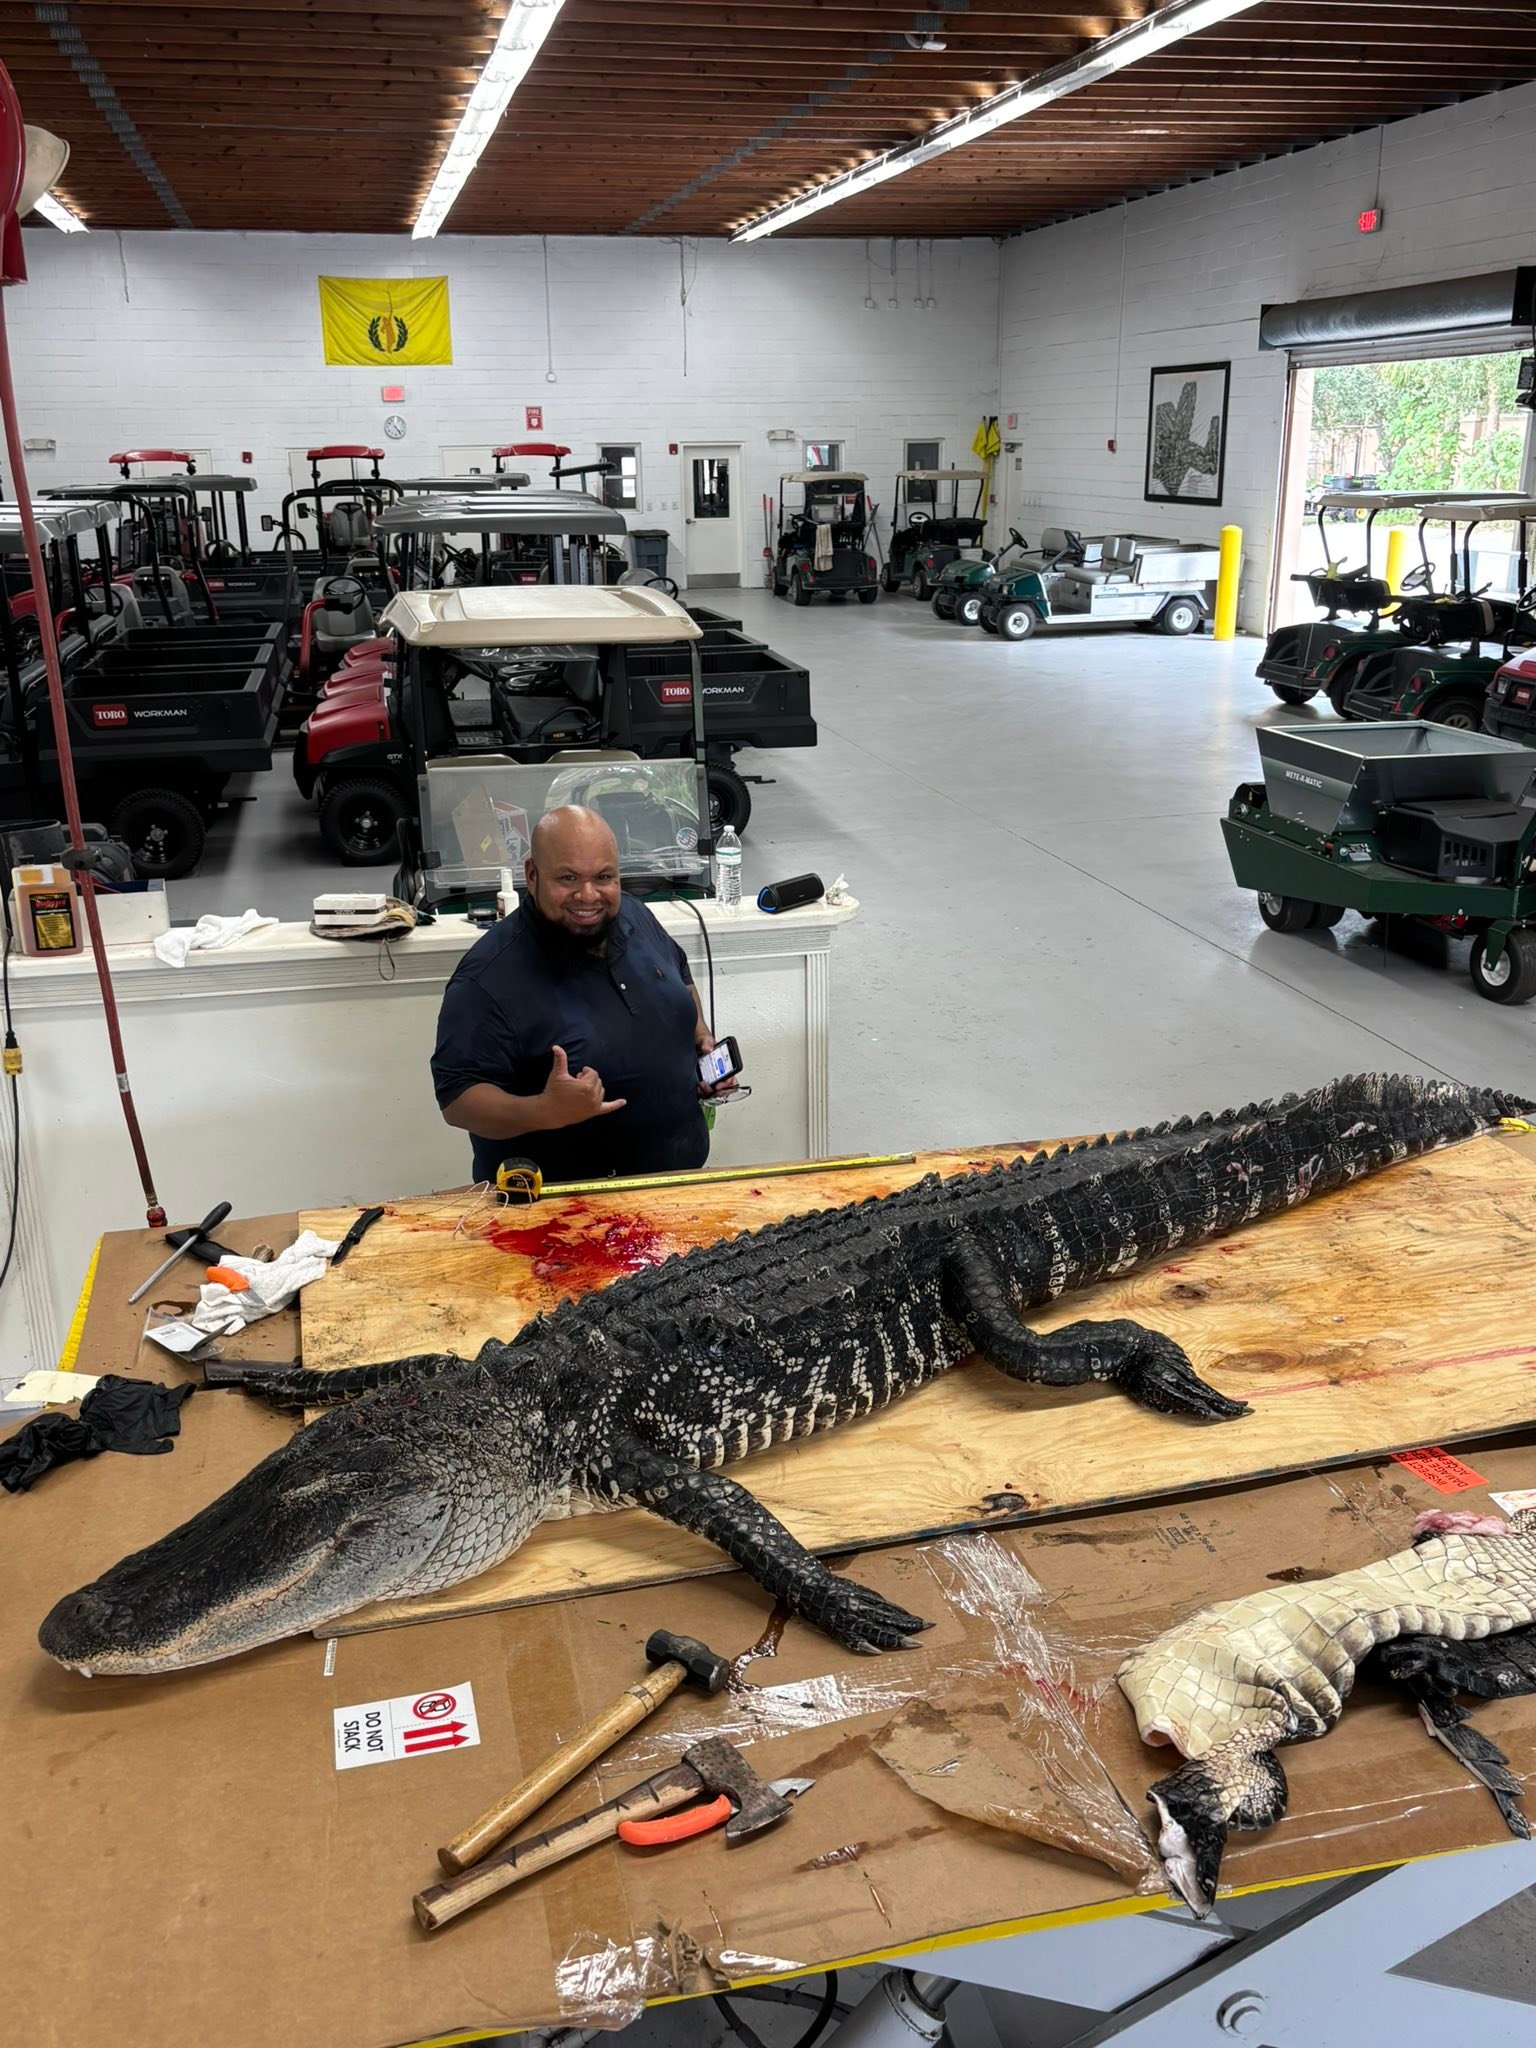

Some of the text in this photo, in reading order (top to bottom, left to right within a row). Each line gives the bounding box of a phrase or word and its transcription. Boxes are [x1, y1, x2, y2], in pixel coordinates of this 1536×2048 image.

[664, 686, 690, 696] TORO
[96, 708, 188, 720] TORO WORKMAN
[1407, 1461, 1447, 1486] INSPECT
[1429, 1463, 1469, 1488] DAMAGE
[343, 1720, 361, 1753] STACK
[365, 1711, 384, 1752] DO NOT
